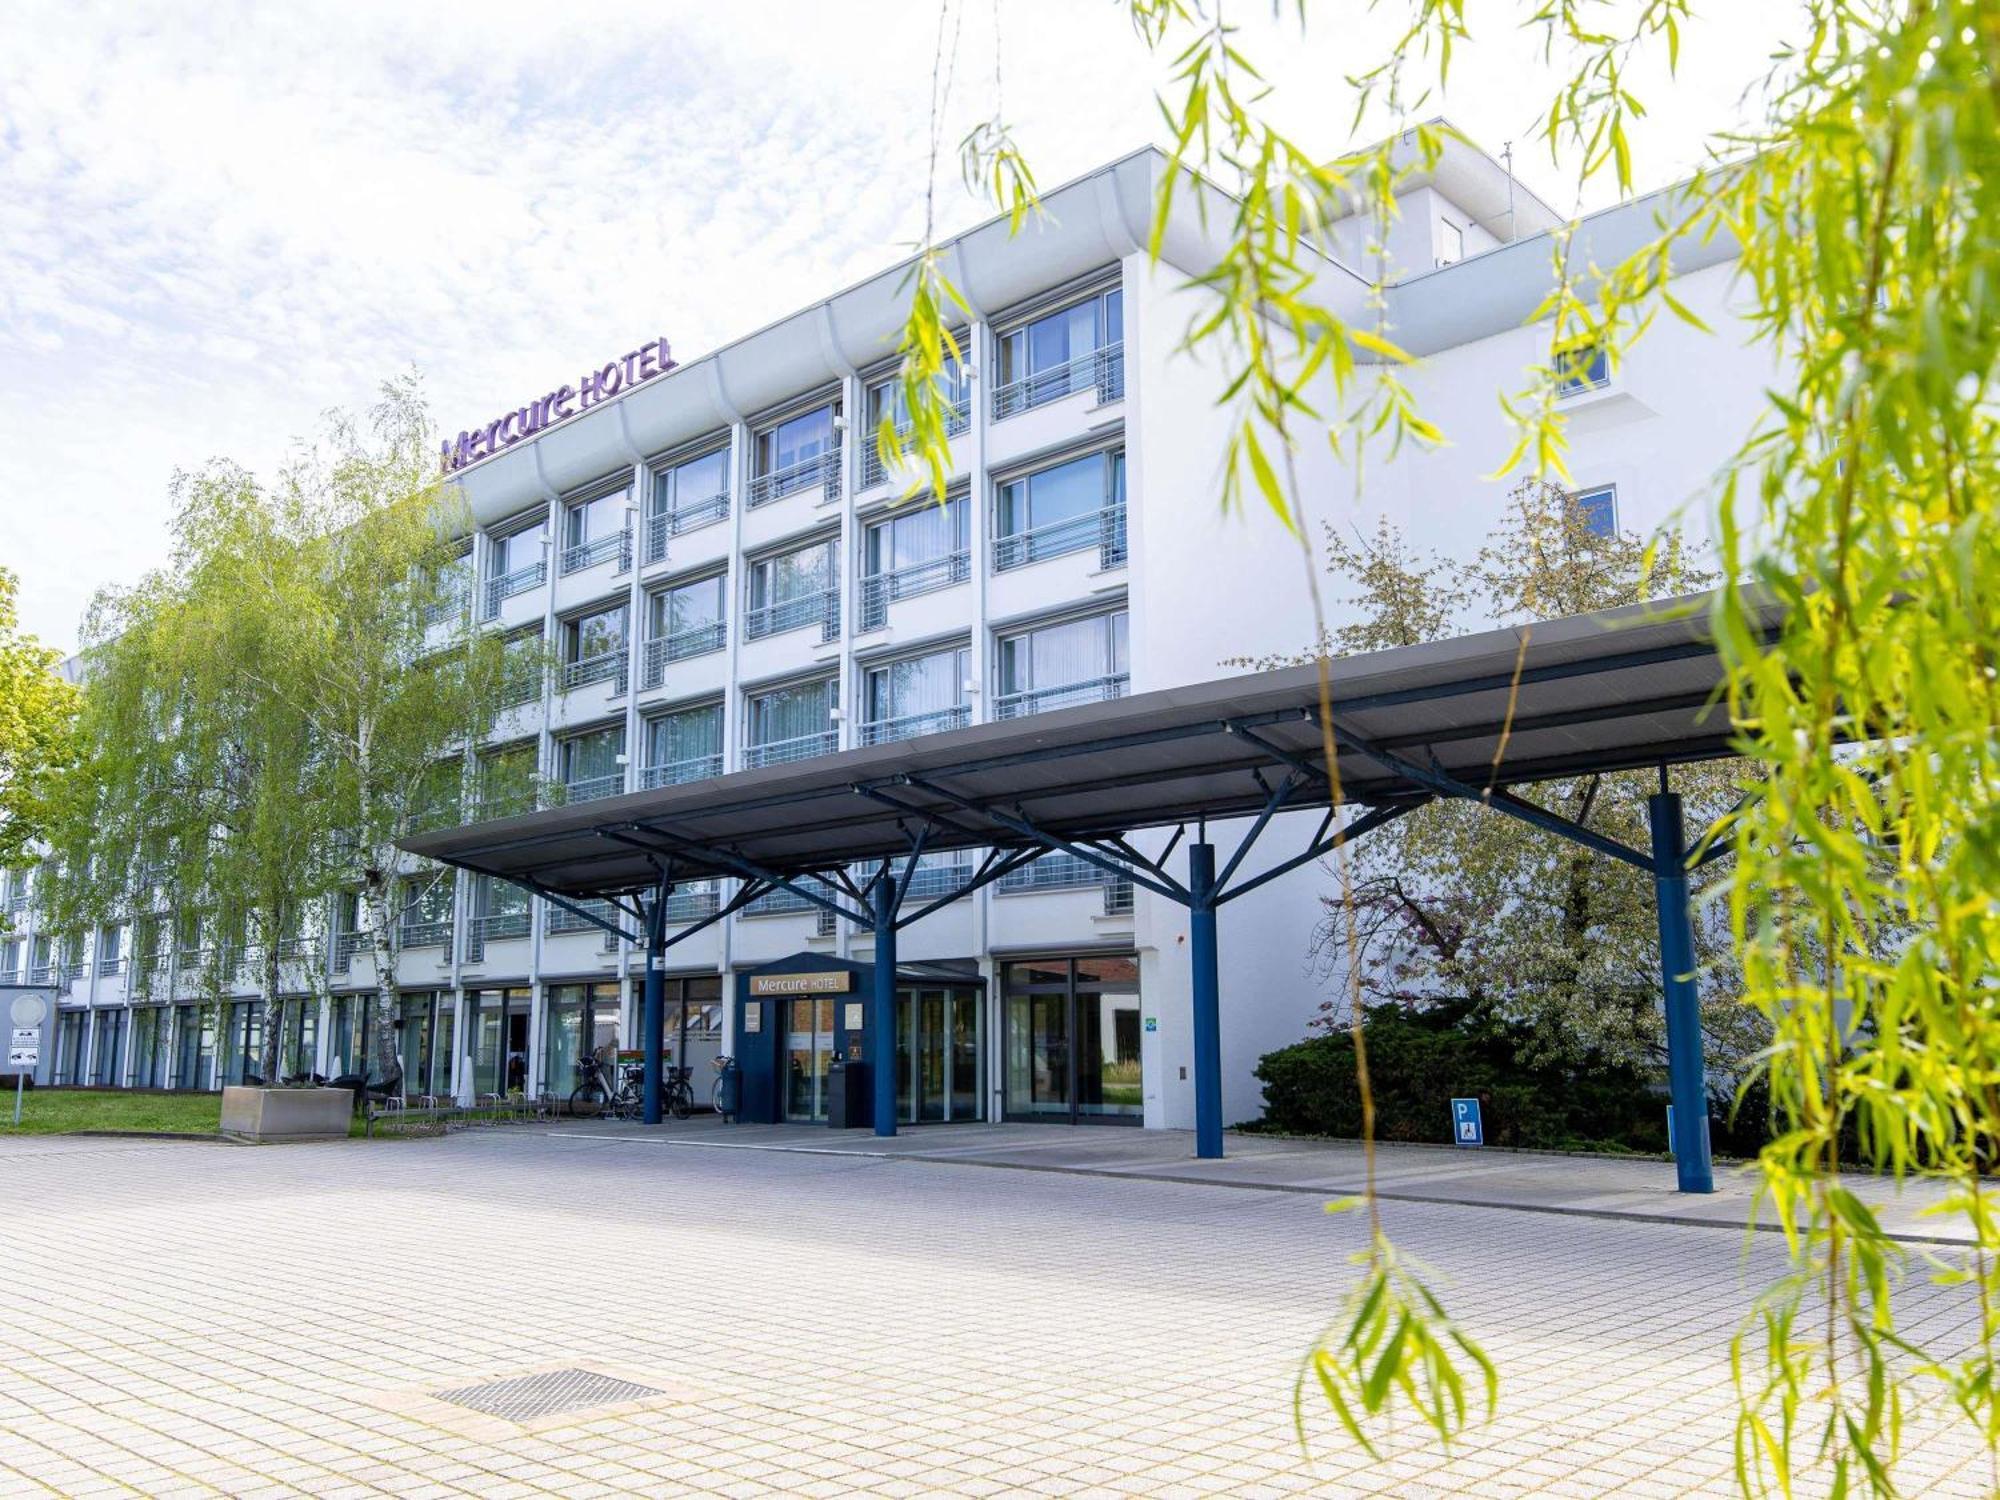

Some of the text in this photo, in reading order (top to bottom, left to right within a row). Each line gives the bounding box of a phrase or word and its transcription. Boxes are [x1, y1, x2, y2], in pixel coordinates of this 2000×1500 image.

[440, 336, 679, 473] Mercure HOTEL
[758, 978, 840, 992] Mercure HOTEL
[1457, 1103, 1468, 1120] P
